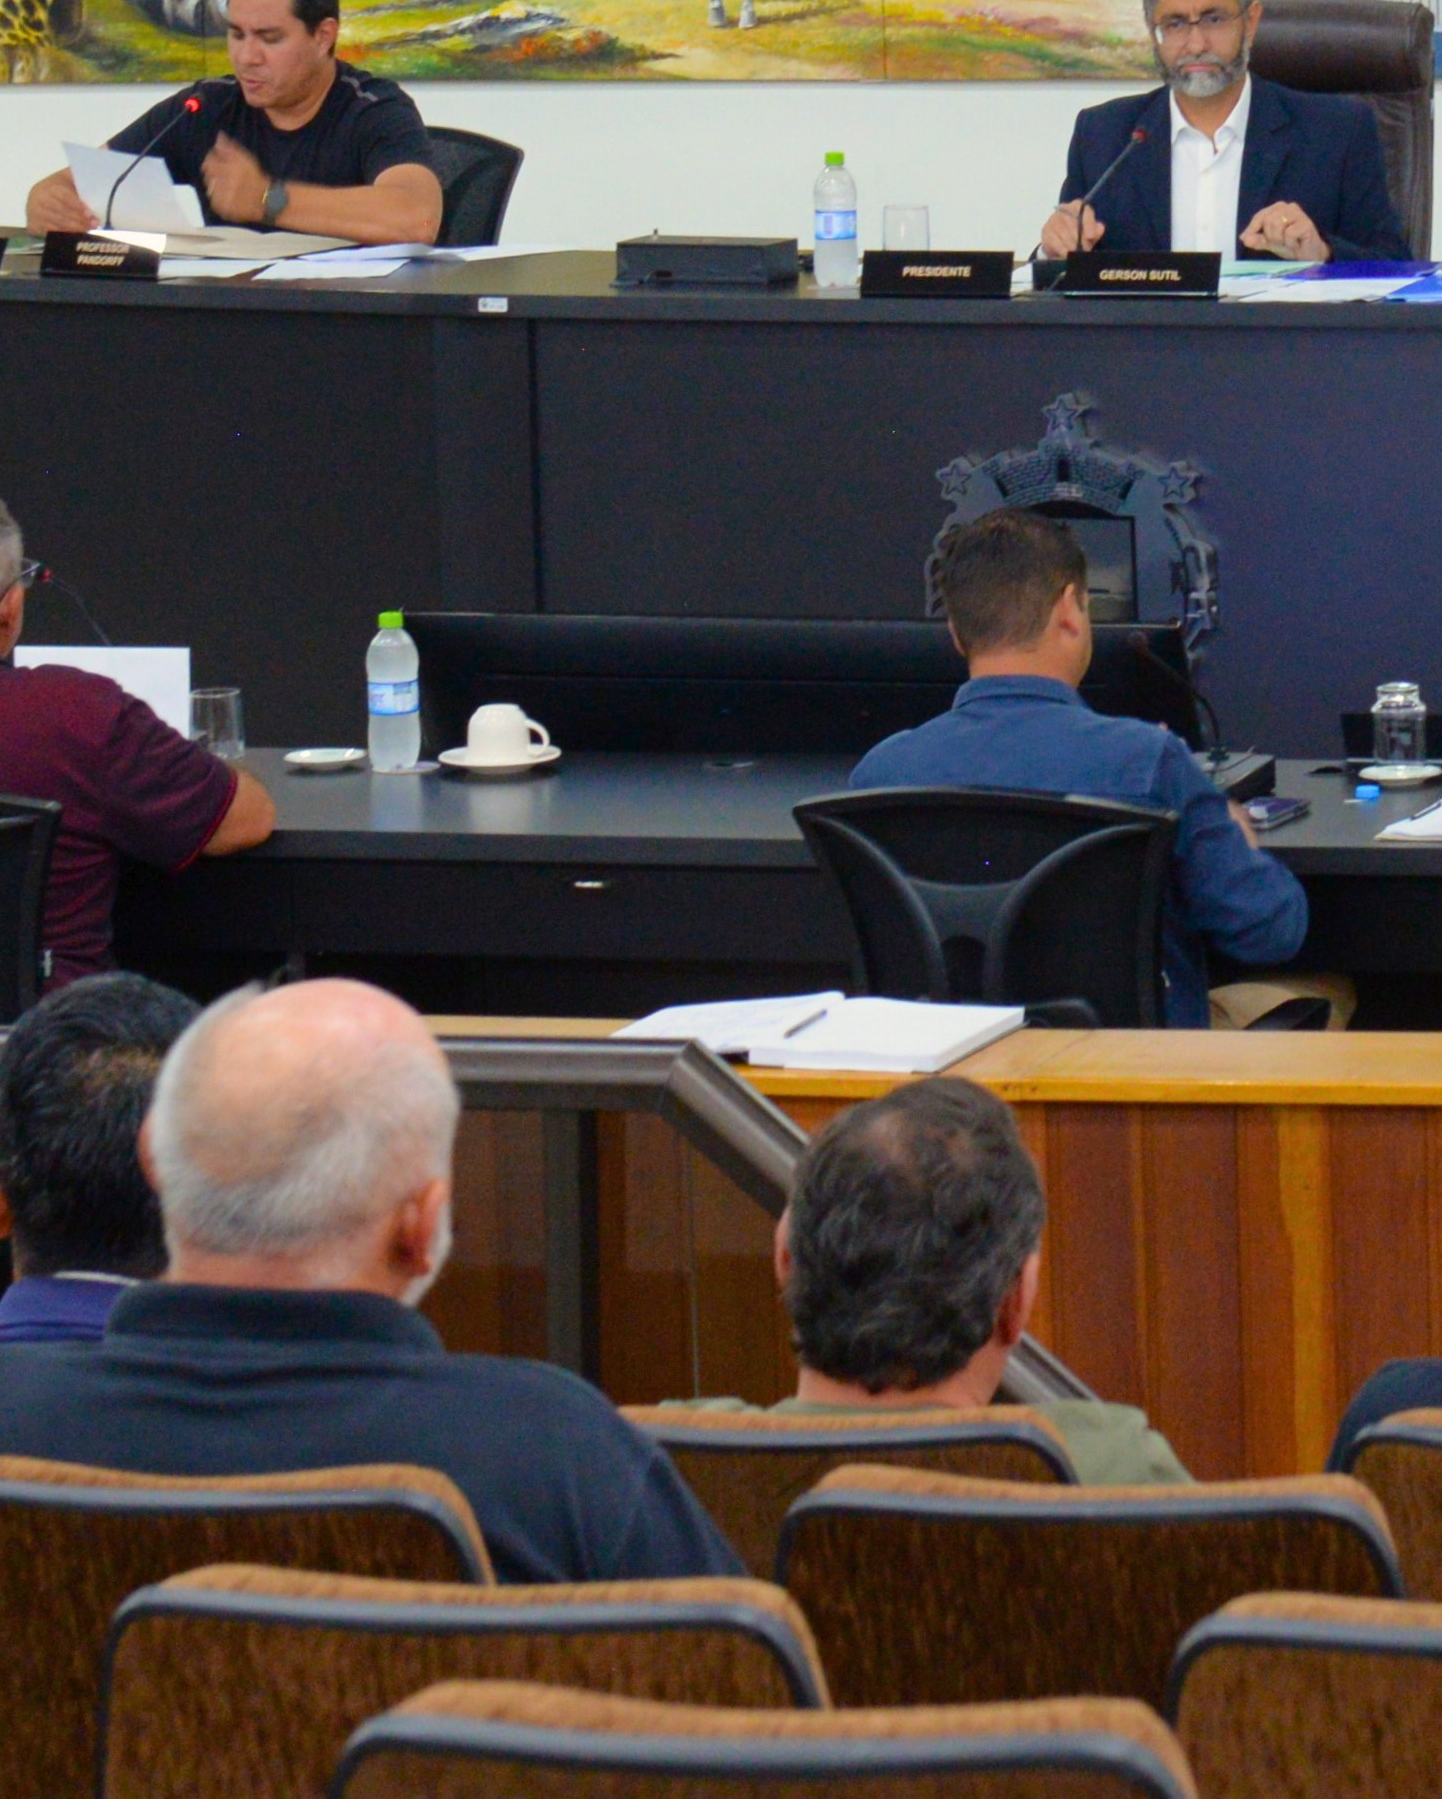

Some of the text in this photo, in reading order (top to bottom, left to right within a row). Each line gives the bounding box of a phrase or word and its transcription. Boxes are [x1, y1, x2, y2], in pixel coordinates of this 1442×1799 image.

[76, 241, 130, 254] PROFESSOR
[902, 265, 972, 278] PRESIDENTE
[1099, 268, 1182, 281] GERSON SUTIL
